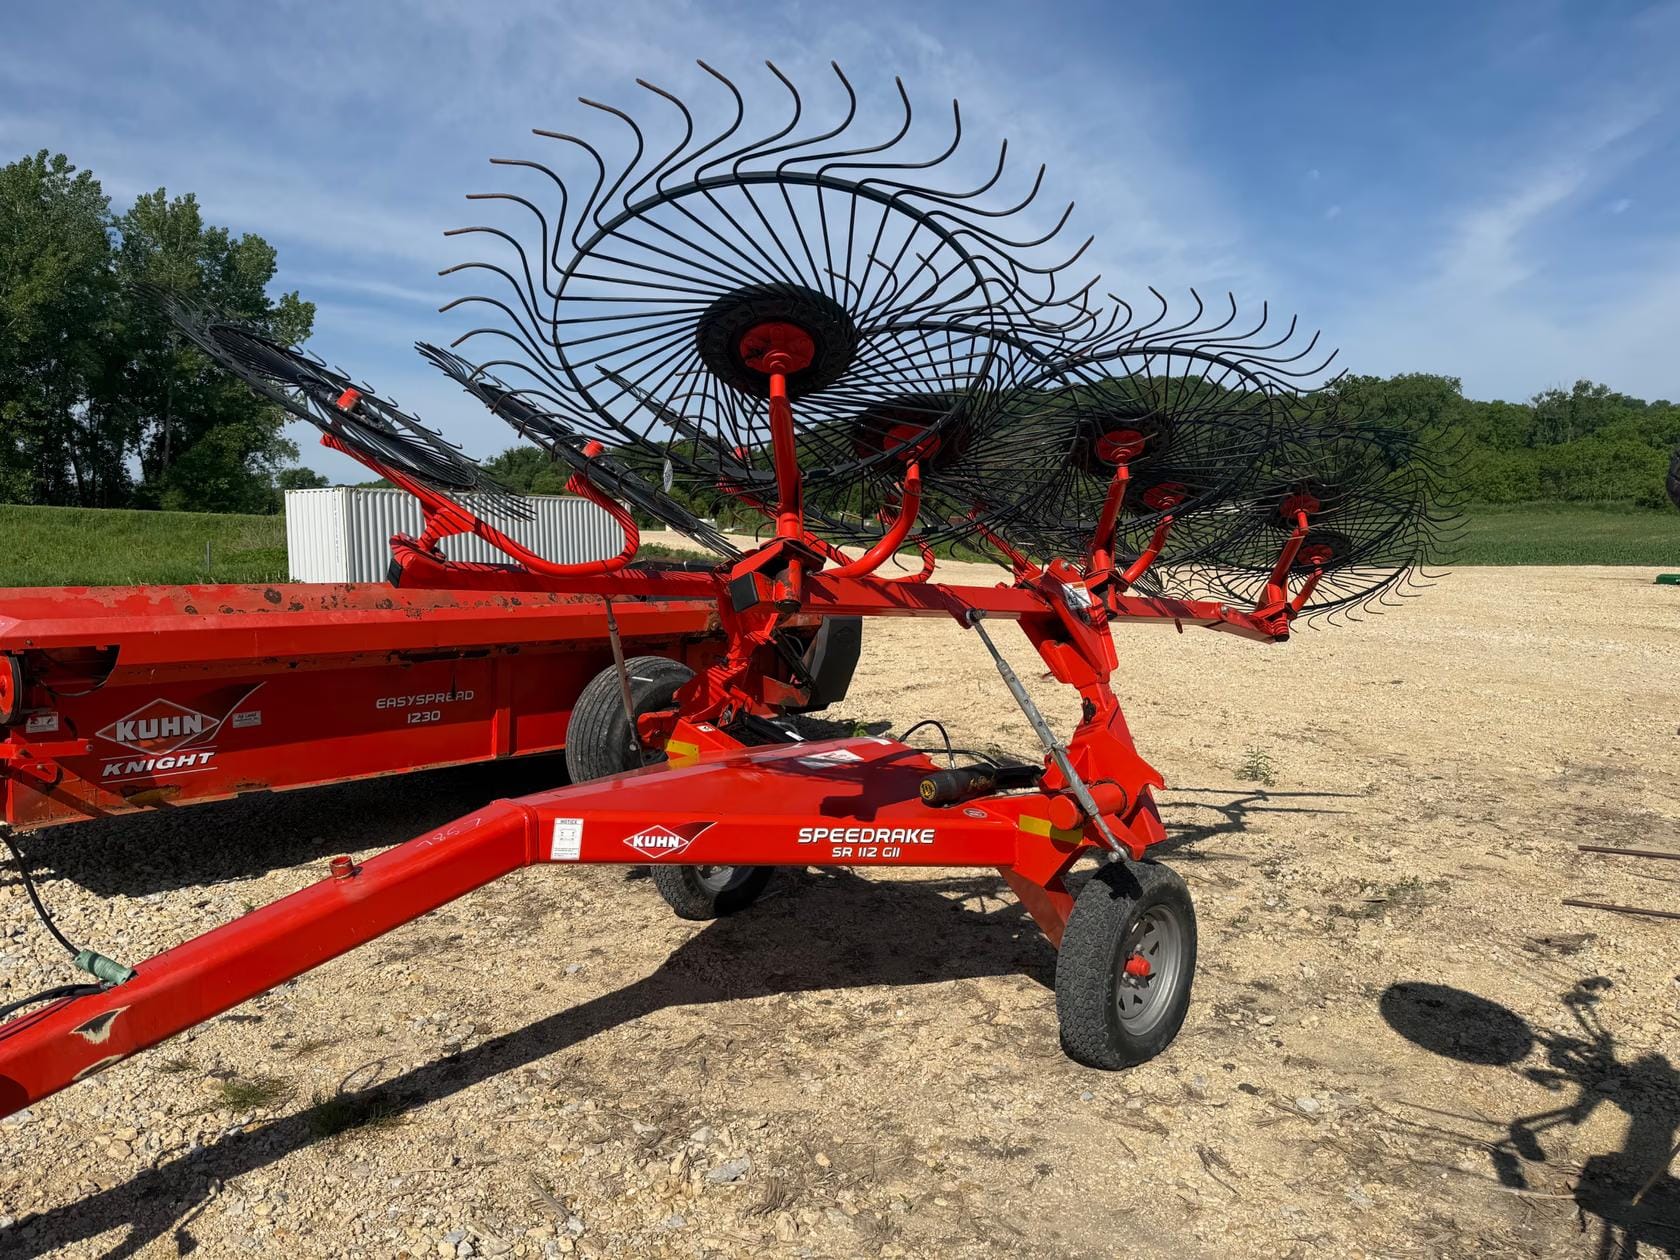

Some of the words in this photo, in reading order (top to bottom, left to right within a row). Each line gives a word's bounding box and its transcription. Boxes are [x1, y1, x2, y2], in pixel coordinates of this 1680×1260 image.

[375, 690, 475, 709] EASYSPREAD
[407, 710, 441, 724] 1230
[116, 714, 203, 742] KUHN
[102, 751, 216, 777] KNIGHT
[632, 835, 680, 848] KUHN
[798, 828, 936, 844] SPEEDRAKE
[832, 847, 853, 858] SR
[858, 847, 878, 858] 112
[882, 847, 901, 858] GII
